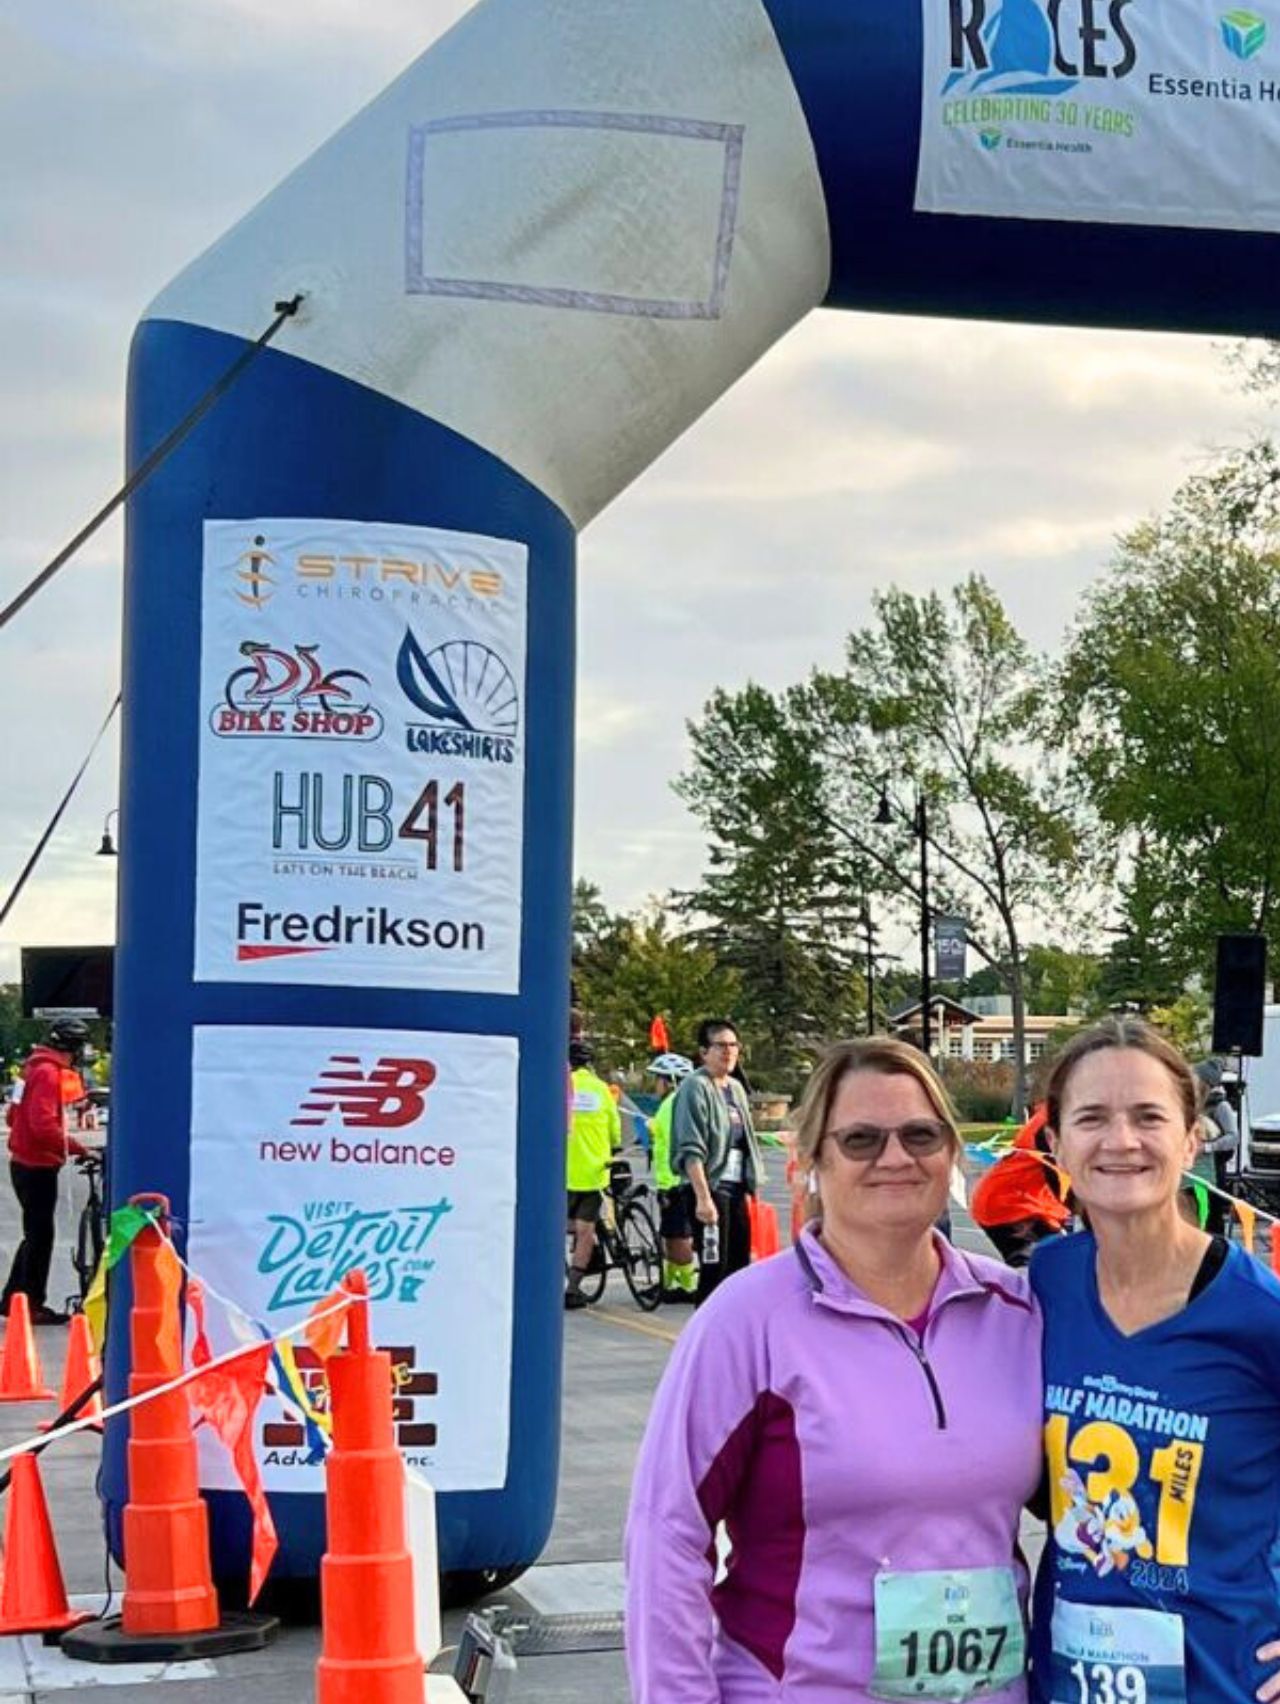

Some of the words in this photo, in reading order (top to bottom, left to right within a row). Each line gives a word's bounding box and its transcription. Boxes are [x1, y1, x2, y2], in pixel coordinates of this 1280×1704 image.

[1148, 72, 1252, 101] Essentia
[942, 96, 1051, 127] CELEBRATING
[1055, 101, 1079, 128] 30
[1082, 105, 1134, 137] YEARS
[1007, 136, 1053, 153] Essentia
[1056, 141, 1093, 154] Health
[297, 555, 503, 596] STRIVE
[219, 710, 285, 733] BIKE
[293, 711, 375, 735] SHOP
[406, 728, 514, 763] LAKESHIRTS
[311, 865, 336, 877] ON
[238, 903, 484, 950] Fredrikson
[260, 1140, 320, 1161] new
[331, 1138, 455, 1167] balance
[304, 1202, 354, 1221] VISIT
[257, 1197, 453, 1273] Detroit
[1084, 1391, 1209, 1441] MARATHON
[1170, 1447, 1194, 1503] MILES
[900, 1626, 1008, 1678] 1067
[1071, 1660, 1147, 1704] 139
